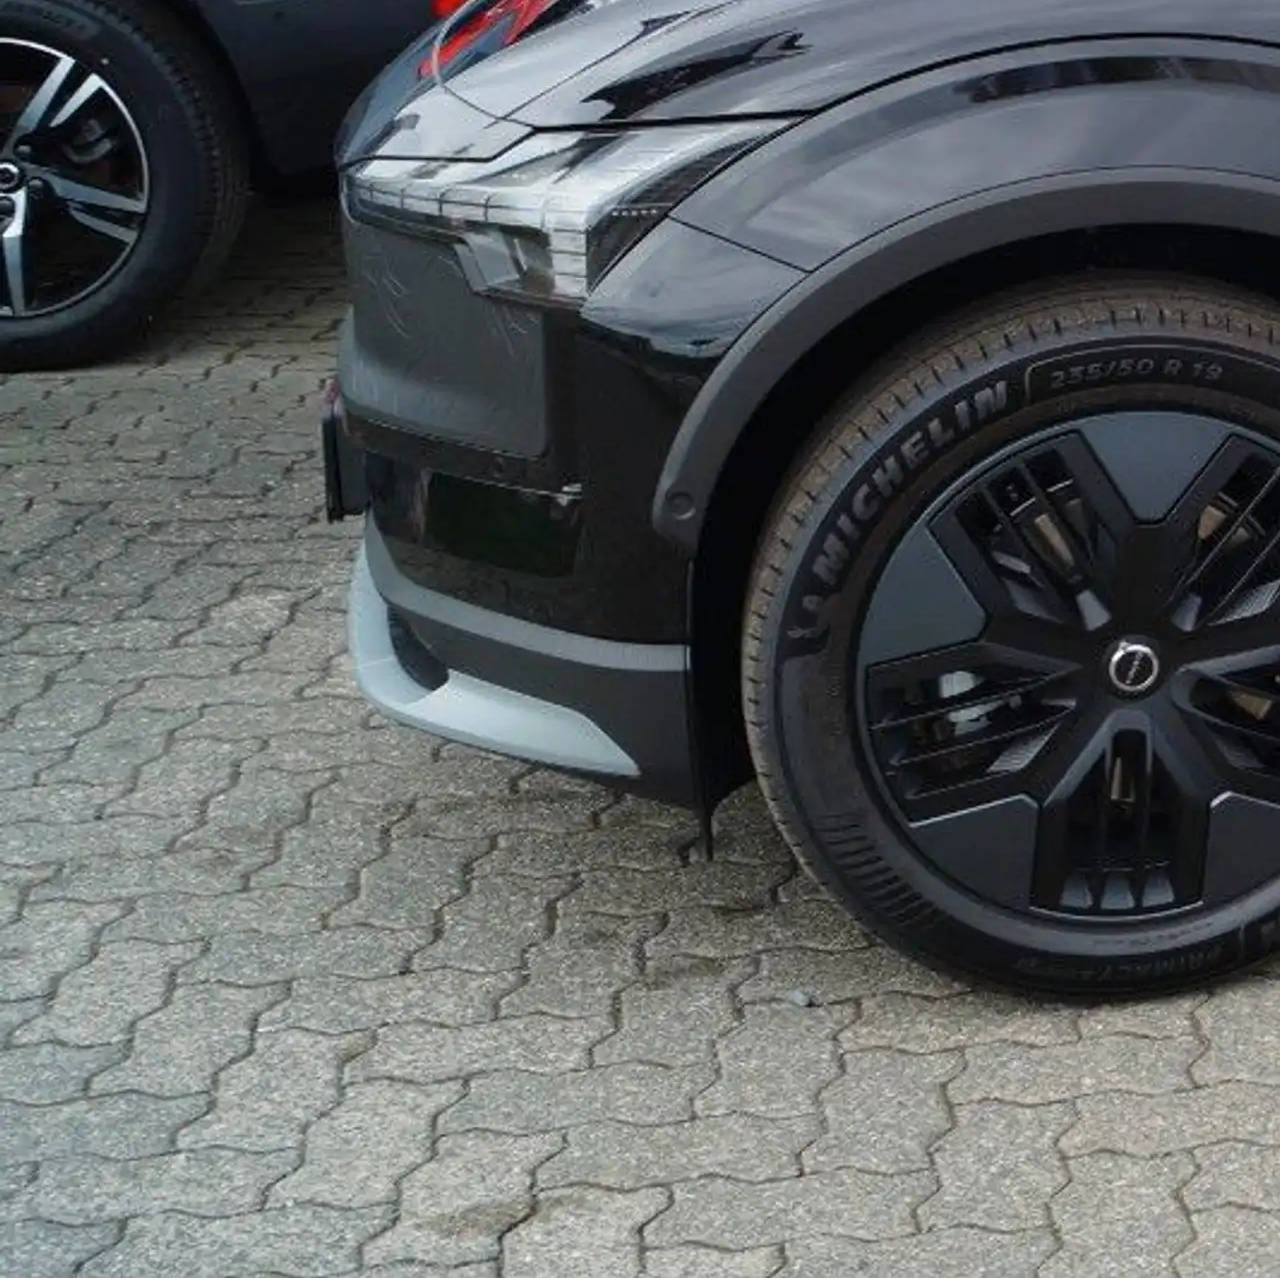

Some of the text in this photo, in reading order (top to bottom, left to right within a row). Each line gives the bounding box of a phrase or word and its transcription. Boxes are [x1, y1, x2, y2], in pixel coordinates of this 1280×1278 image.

[1051, 358, 1224, 388] 235/50 R 19
[812, 379, 1008, 588] MICHELIN
